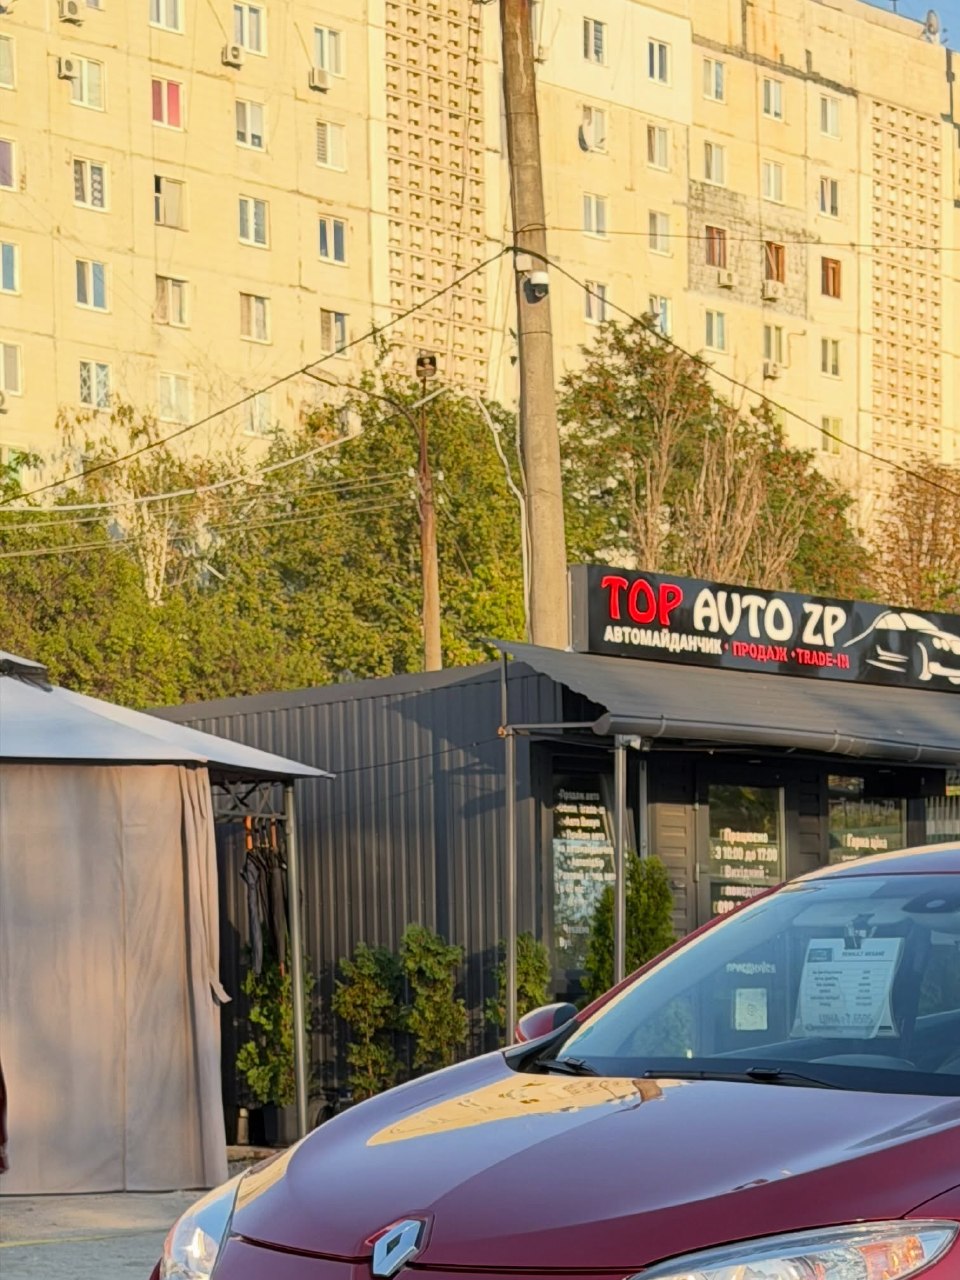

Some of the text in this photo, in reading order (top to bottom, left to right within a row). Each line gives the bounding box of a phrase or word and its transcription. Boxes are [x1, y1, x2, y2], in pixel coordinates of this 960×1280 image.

[602, 575, 684, 627] TOP
[801, 602, 847, 648] ZP
[603, 624, 788, 664] АВТОМАЙДАНЧИК ПРОДАЖ
[797, 650, 850, 670] TRADE-IN
